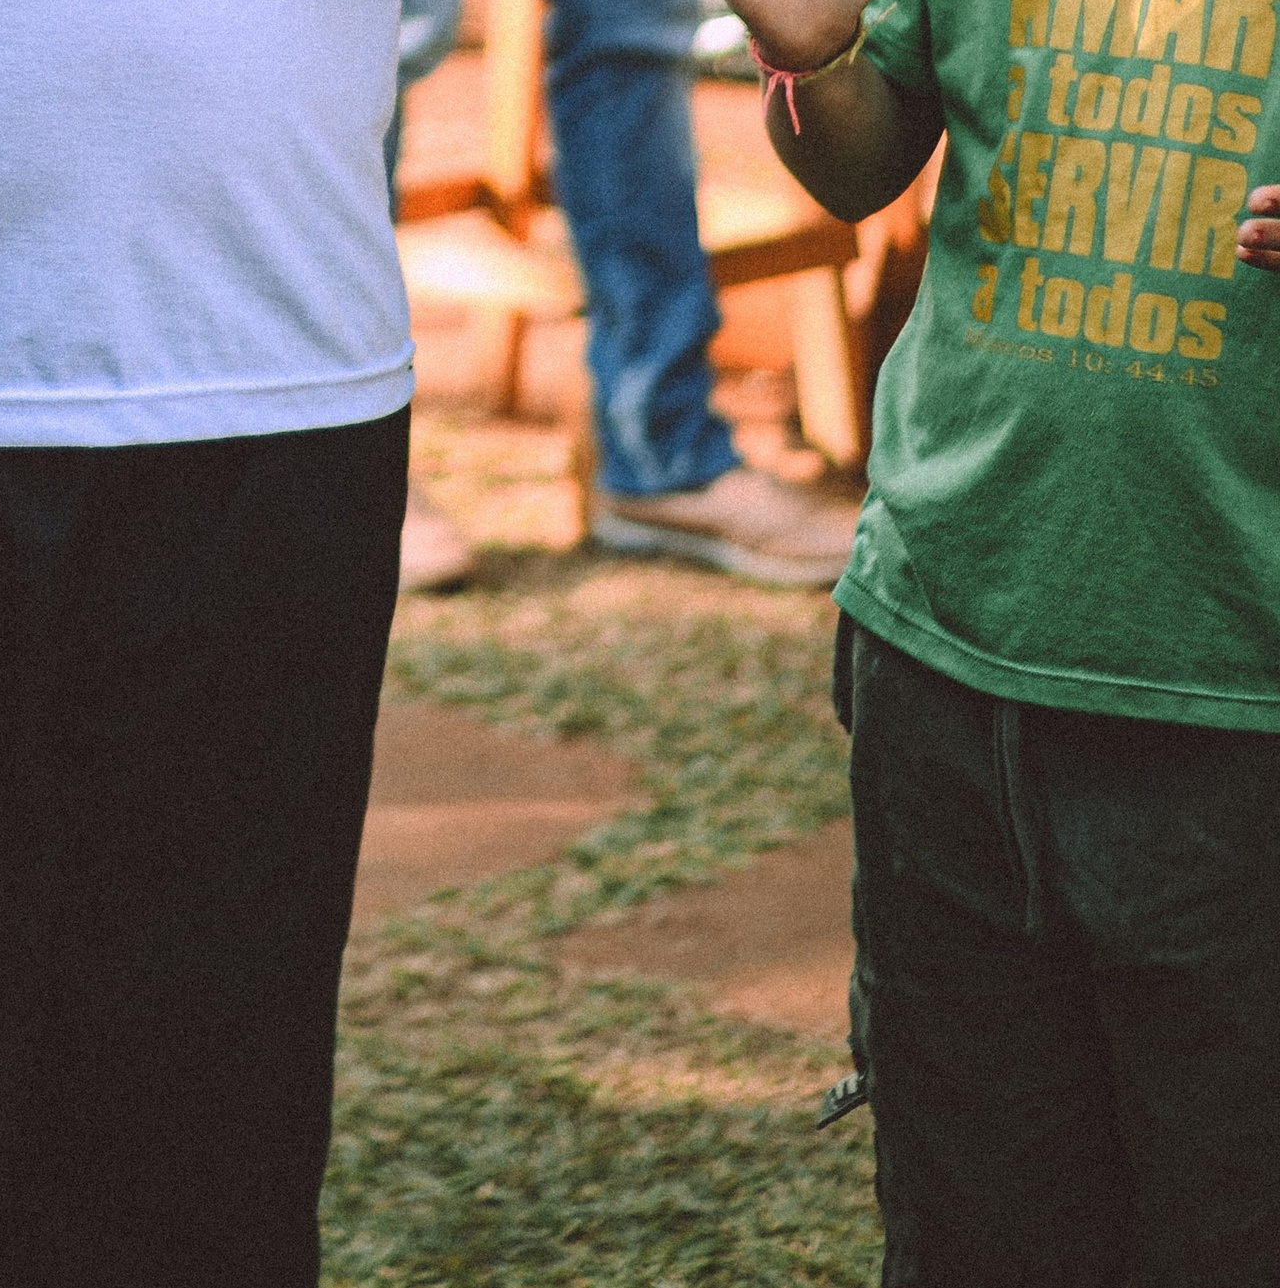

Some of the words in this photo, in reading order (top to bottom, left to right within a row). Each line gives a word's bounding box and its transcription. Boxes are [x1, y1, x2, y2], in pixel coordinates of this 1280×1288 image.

[1046, 52, 1263, 155] todos
[977, 129, 1247, 280] SERVIR
[972, 264, 998, 324] a
[1017, 257, 1227, 361] todos
